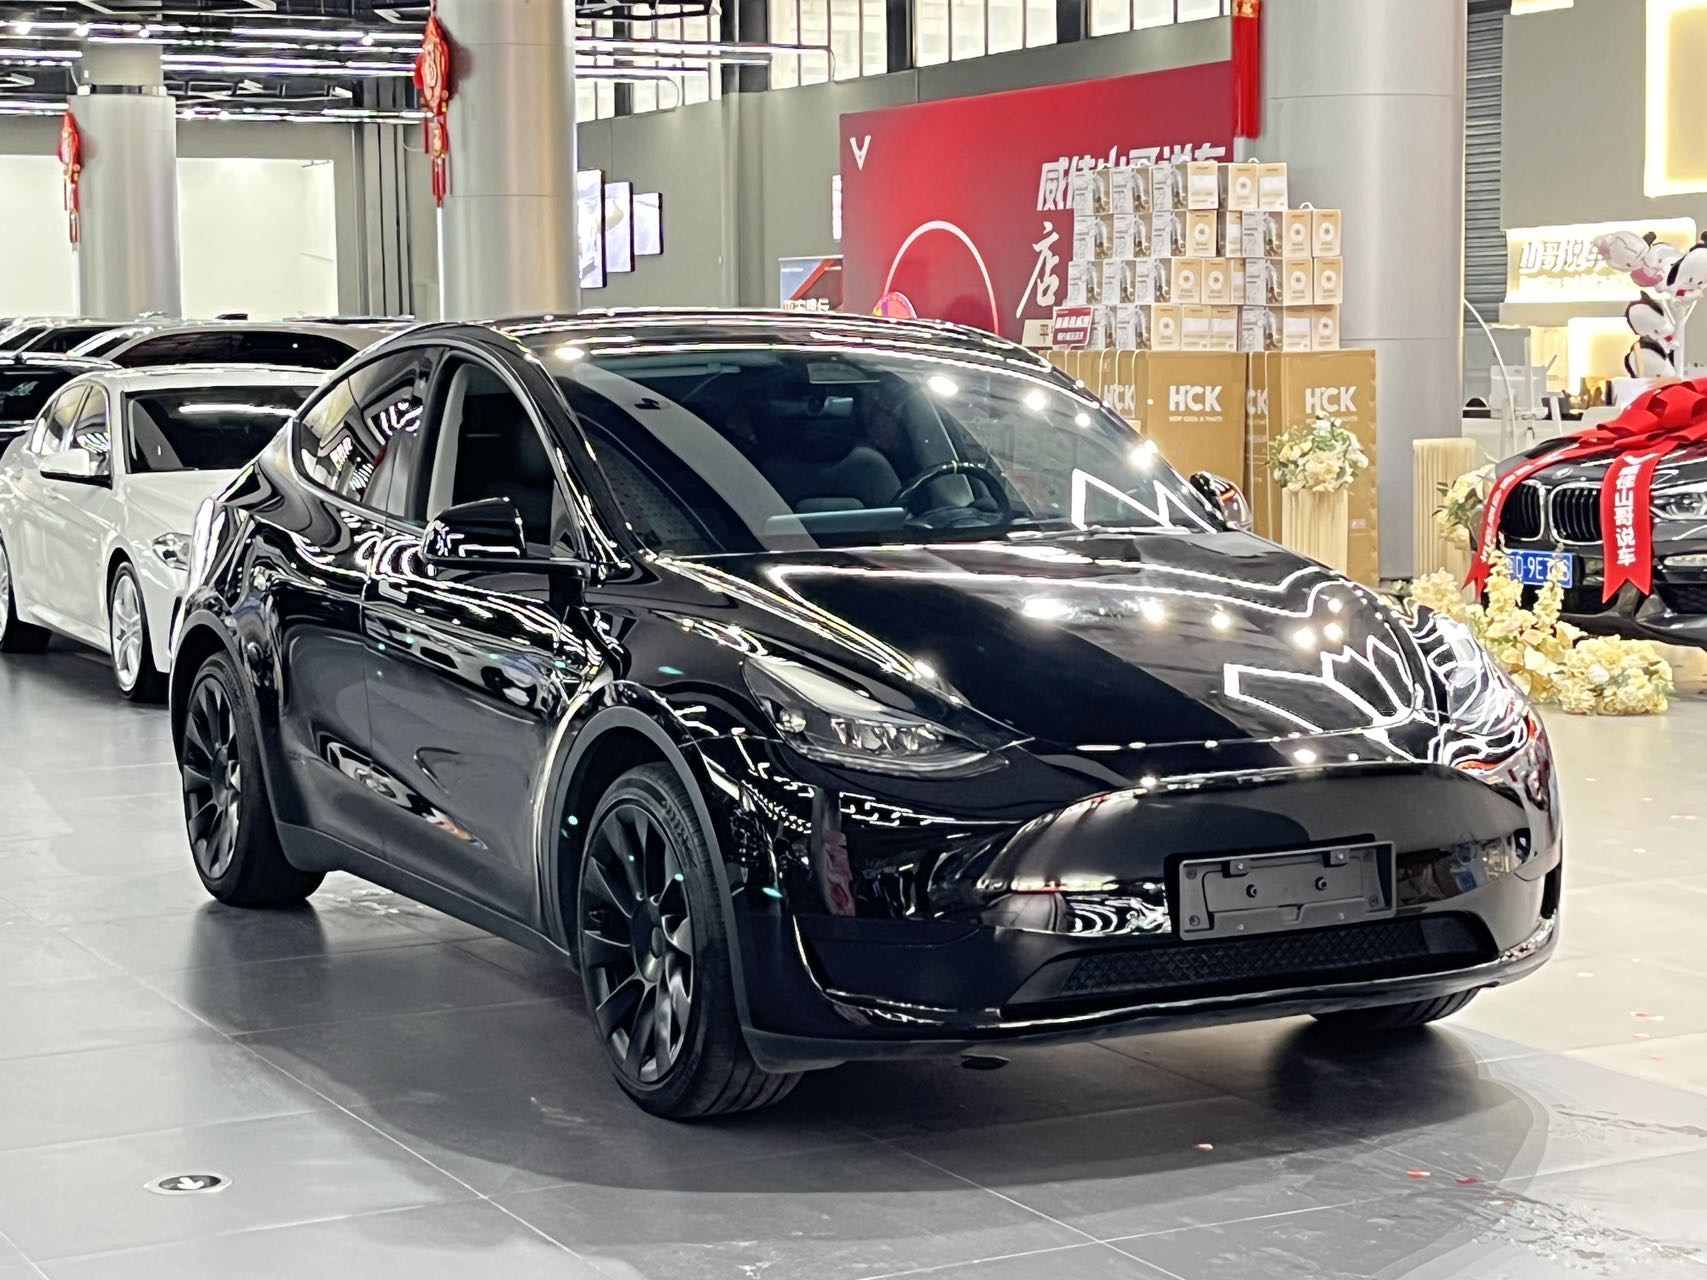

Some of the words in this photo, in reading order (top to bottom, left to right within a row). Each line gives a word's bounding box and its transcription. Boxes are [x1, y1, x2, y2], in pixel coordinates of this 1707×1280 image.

[1016, 221, 1060, 318] 店
[1103, 384, 1136, 412] HCK
[1169, 384, 1223, 412] HCK
[1247, 389, 1269, 416] CK
[1305, 385, 1357, 414] HCK
